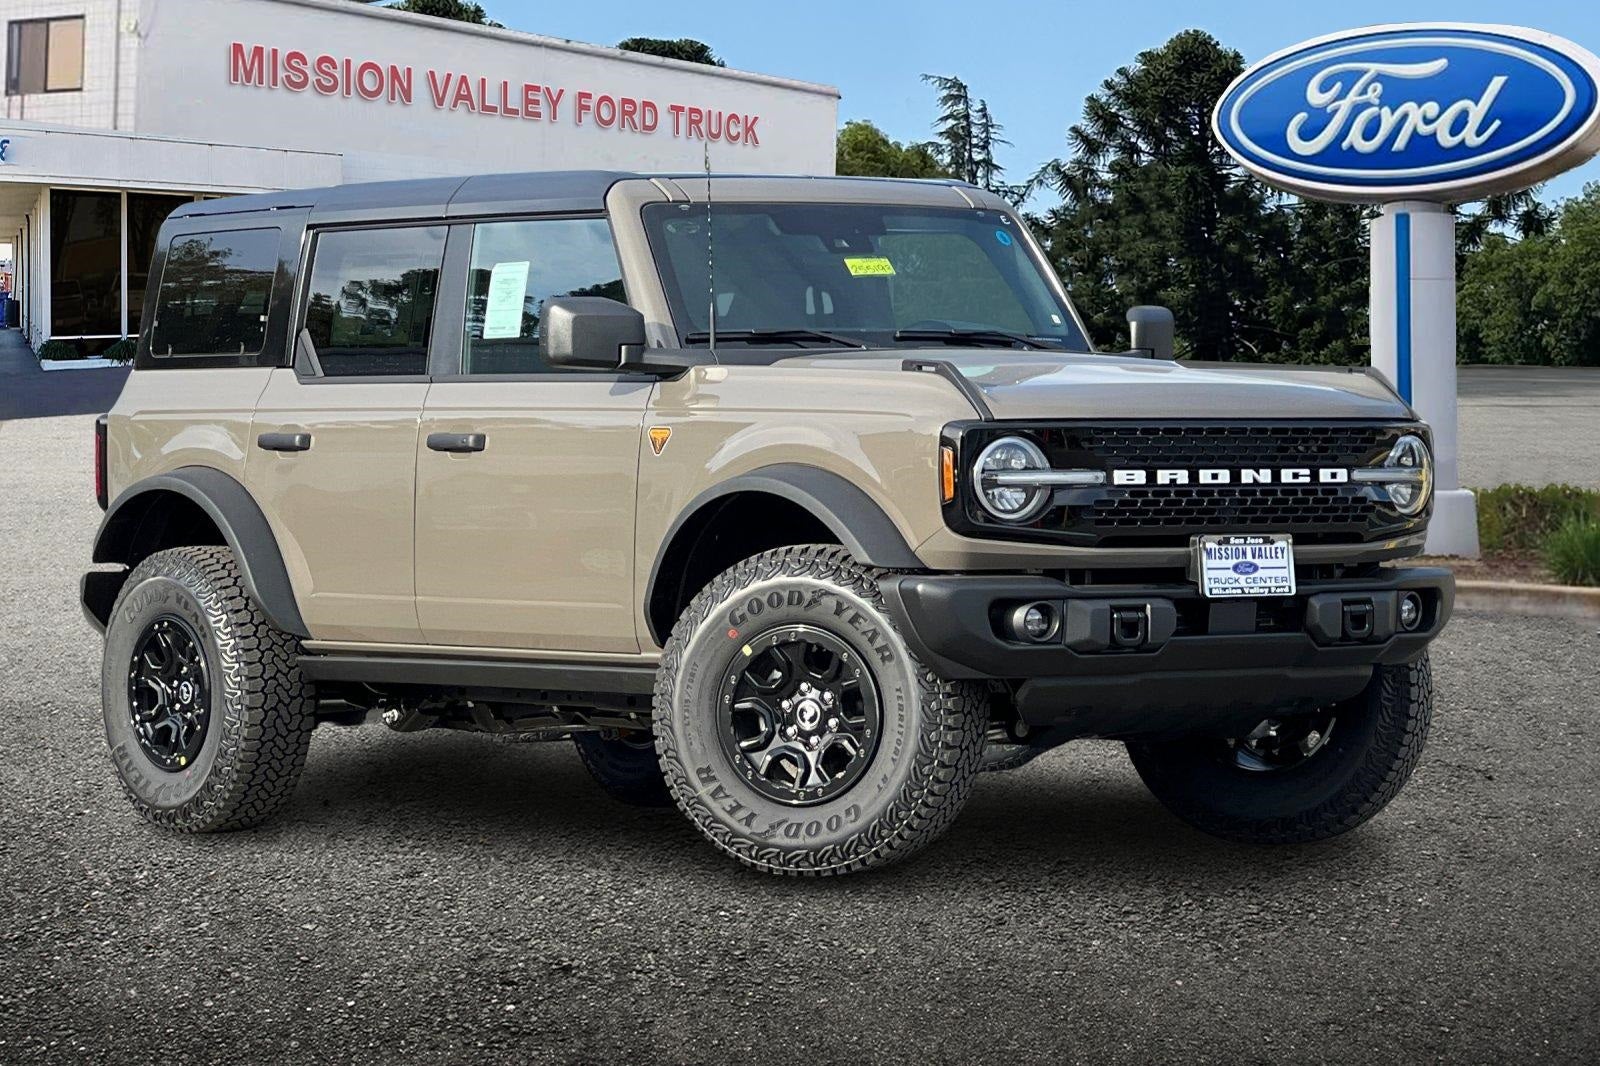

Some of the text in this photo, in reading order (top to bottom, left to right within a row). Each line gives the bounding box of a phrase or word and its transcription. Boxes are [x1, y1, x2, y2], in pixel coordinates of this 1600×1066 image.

[230, 41, 760, 146] MISSION VALLEY FORD TRUCK
[1286, 58, 1509, 156] Ford
[1113, 468, 1348, 485] BRONCO
[1206, 546, 1286, 560] MISSION VALLEY
[1208, 576, 1289, 585] TRUCK CENTER
